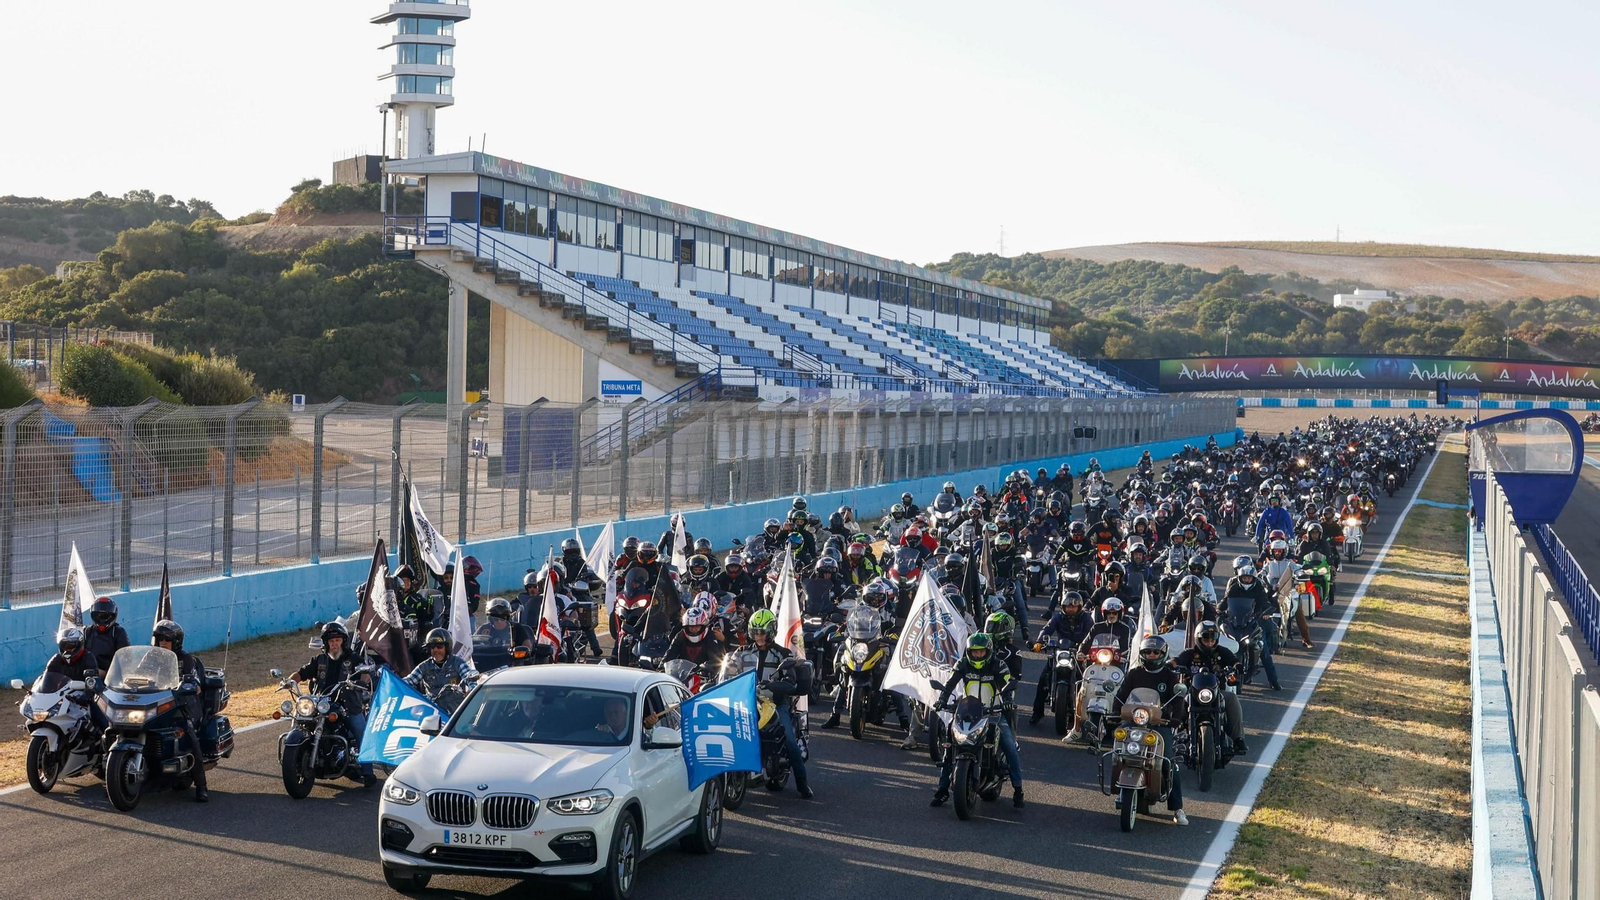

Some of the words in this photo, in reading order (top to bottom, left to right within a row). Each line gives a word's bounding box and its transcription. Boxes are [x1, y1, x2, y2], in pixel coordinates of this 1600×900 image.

[1178, 362, 1250, 381] Andalucía
[1293, 360, 1366, 379] Andalucía
[1408, 362, 1482, 383] Andalucía
[1526, 369, 1600, 390] Andalucía
[603, 383, 626, 391] TRIBUNA
[626, 383, 641, 391] META
[740, 701, 752, 742] JEREZ
[692, 697, 736, 767] 40
[453, 832, 482, 845] 3812
[485, 834, 507, 846] KPF
